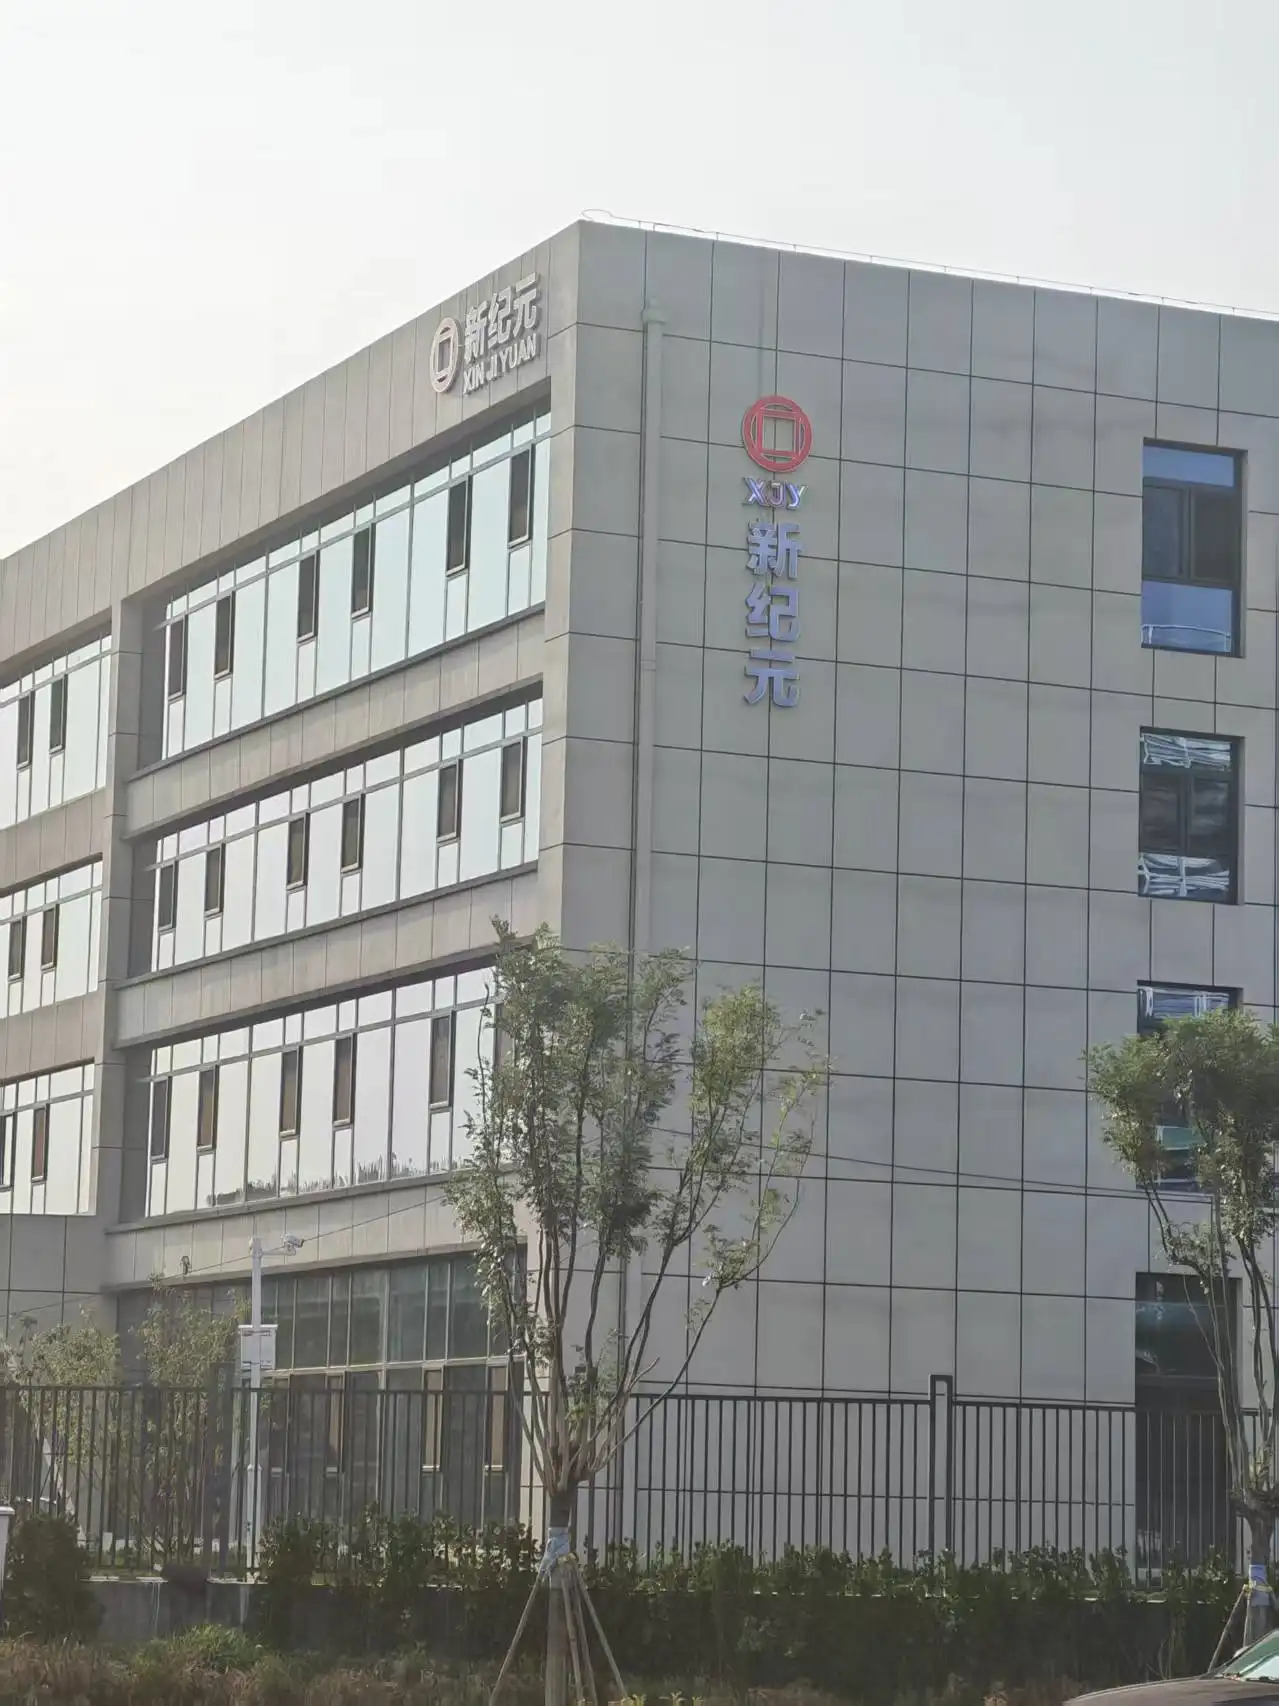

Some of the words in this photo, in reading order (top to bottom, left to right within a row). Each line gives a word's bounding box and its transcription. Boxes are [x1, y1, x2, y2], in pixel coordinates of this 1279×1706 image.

[463, 360, 485, 396] XIN
[486, 353, 498, 381] JI
[499, 332, 537, 373] YUAN
[464, 272, 537, 365] 新纪元
[744, 521, 803, 709] 新纪元
